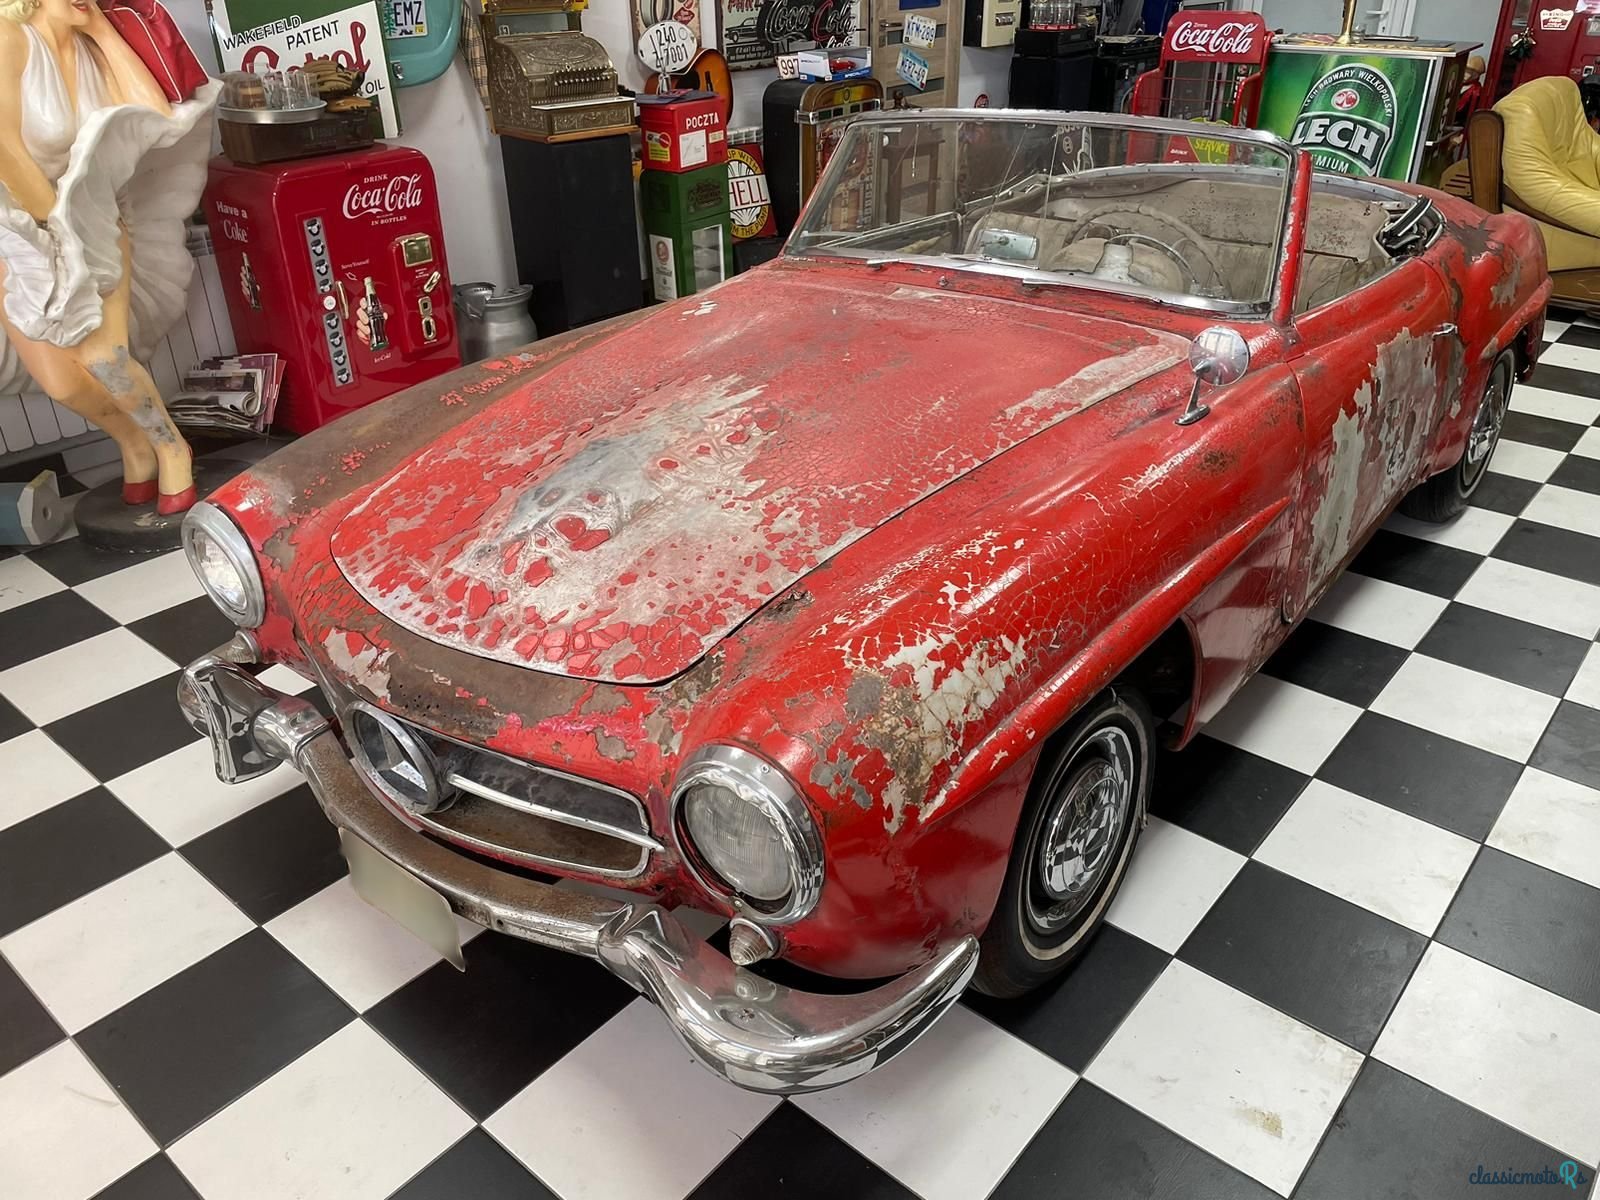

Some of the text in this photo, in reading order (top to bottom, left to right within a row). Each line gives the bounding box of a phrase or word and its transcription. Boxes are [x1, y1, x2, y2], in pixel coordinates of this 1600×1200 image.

[393, 0, 423, 26] EMZ
[223, 15, 302, 50] WAKEFIELD
[286, 20, 340, 50] PATENT
[1170, 21, 1259, 53] Coca-Cola
[365, 80, 386, 94] OIL
[1358, 70, 1393, 118] WIELKOPOLSKI
[685, 112, 720, 130] POCZTA
[1291, 118, 1380, 161] LECH
[363, 173, 389, 184] DRINK
[342, 173, 423, 219] Coca-Cola
[729, 178, 768, 207] HELL
[216, 201, 249, 219] Have a
[380, 215, 407, 225] BOTTLES
[223, 219, 249, 244] Coke
[741, 228, 754, 237] THE
